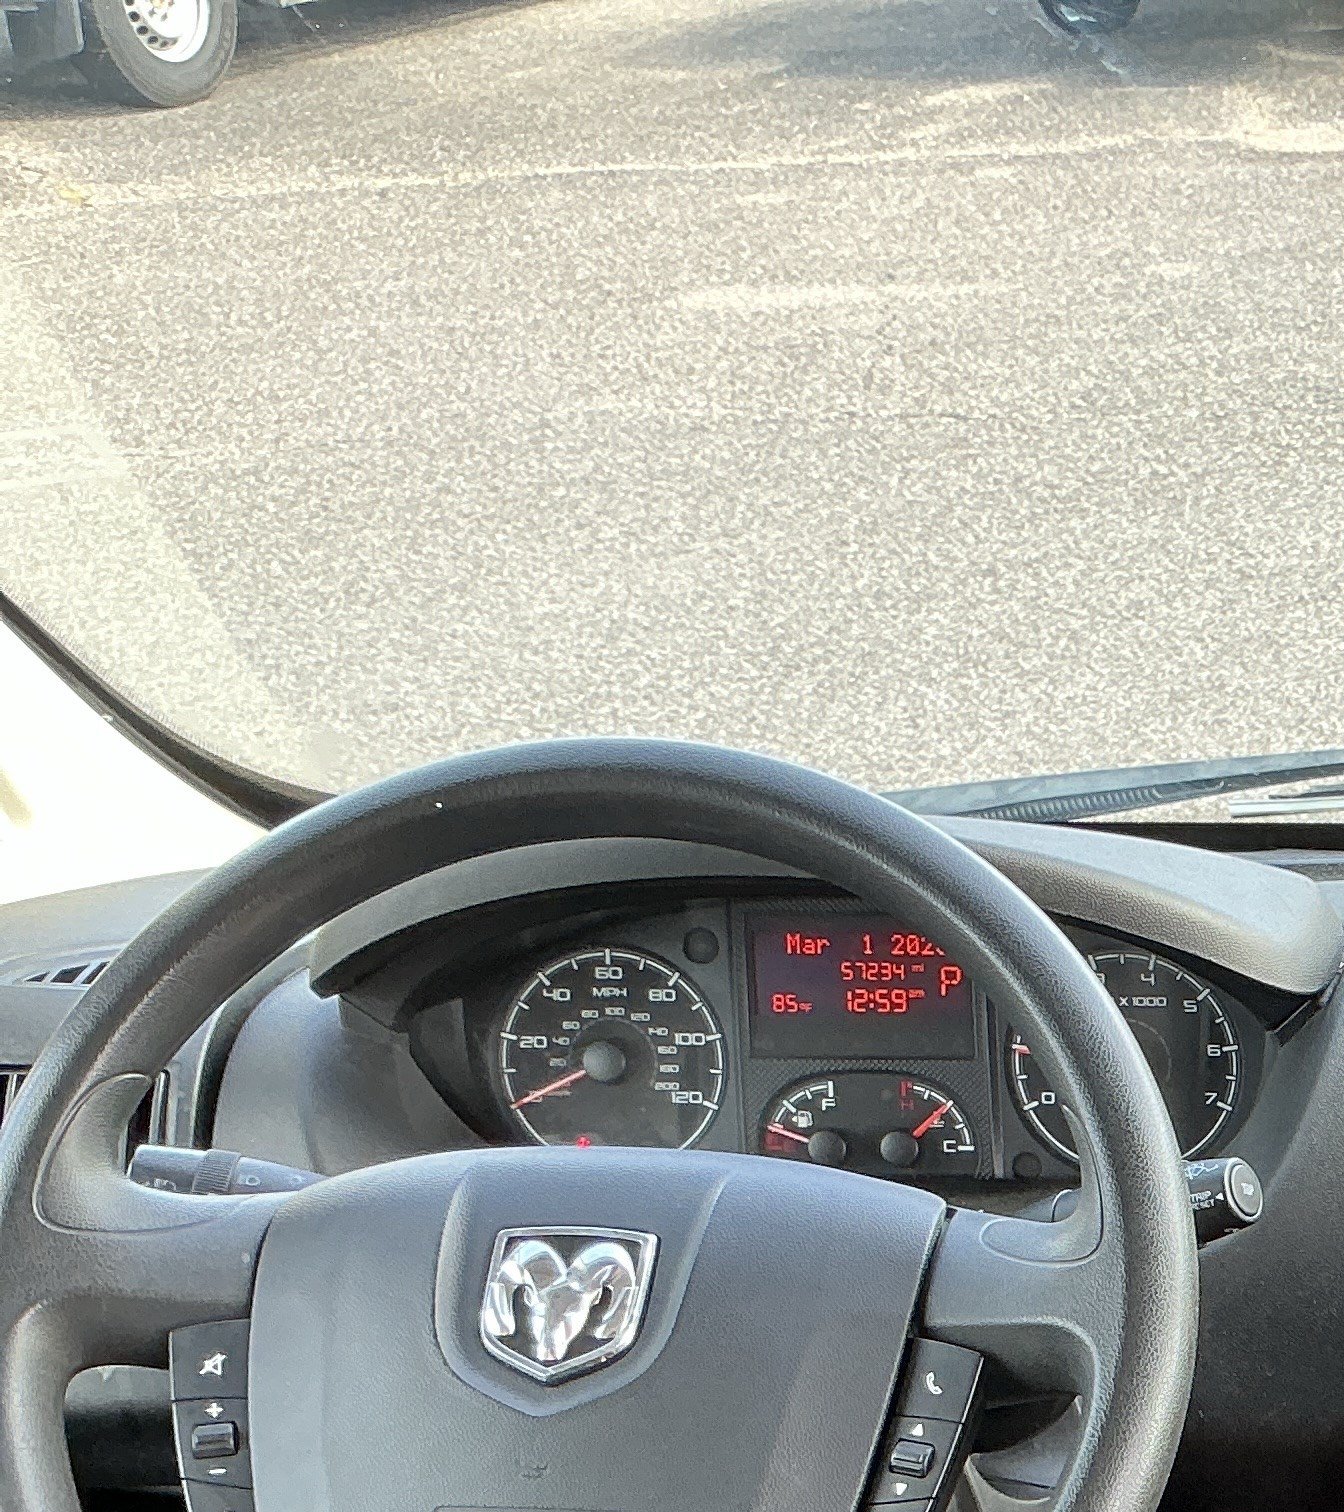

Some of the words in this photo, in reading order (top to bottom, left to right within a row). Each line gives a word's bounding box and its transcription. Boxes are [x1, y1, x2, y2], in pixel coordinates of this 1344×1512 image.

[785, 932, 831, 956] Mar
[862, 933, 874, 955] 1
[890, 933, 947, 956] 202
[595, 966, 623, 980] 60
[840, 962, 906, 981] 57234
[939, 966, 962, 997] P
[1139, 973, 1156, 987] 4
[542, 988, 571, 1002] 40
[592, 986, 628, 998] MPH
[648, 988, 677, 1002] 80
[1132, 996, 1168, 1007] 1000
[1183, 999, 1199, 1014] 5
[519, 1035, 548, 1049] 20
[674, 1032, 706, 1047] 100
[1206, 1044, 1222, 1058] 6
[670, 1091, 704, 1105] 120
[821, 1098, 836, 1112] F
[1040, 1091, 1056, 1105] 0
[1203, 1092, 1219, 1106] 7
[942, 1139, 957, 1153] C
